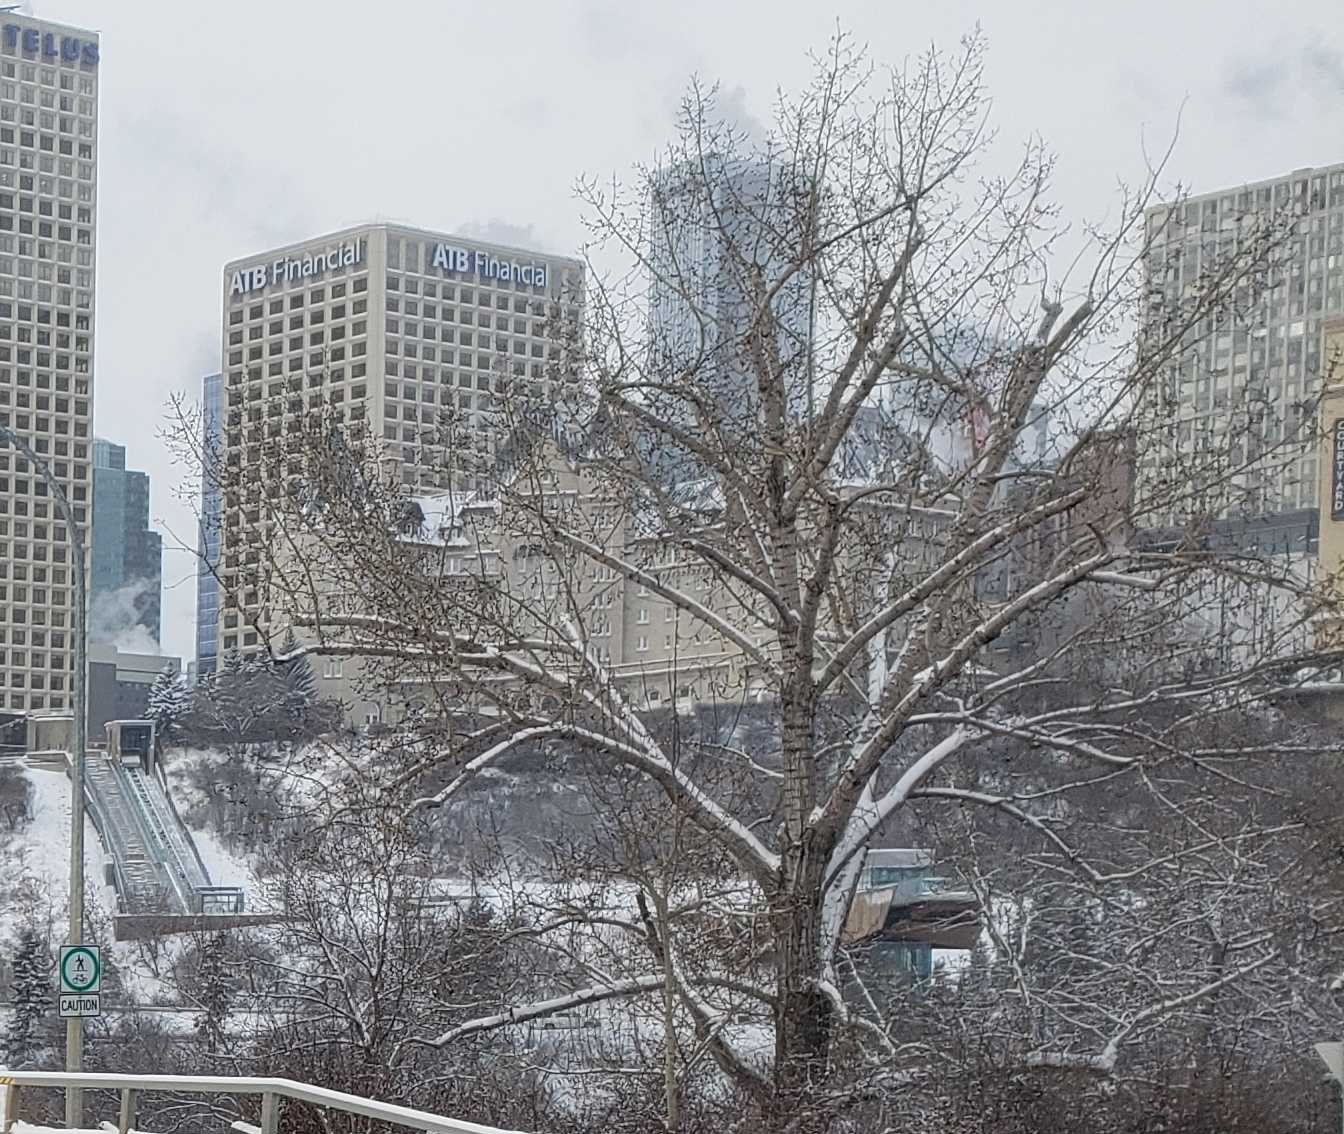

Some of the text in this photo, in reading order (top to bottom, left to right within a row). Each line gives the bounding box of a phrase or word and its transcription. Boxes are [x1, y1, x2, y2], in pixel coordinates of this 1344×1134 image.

[2, 24, 99, 65] TELUS
[229, 236, 361, 296] ATB Financial
[433, 242, 549, 288] ATB Financial
[62, 1000, 97, 1011] CAUTION
